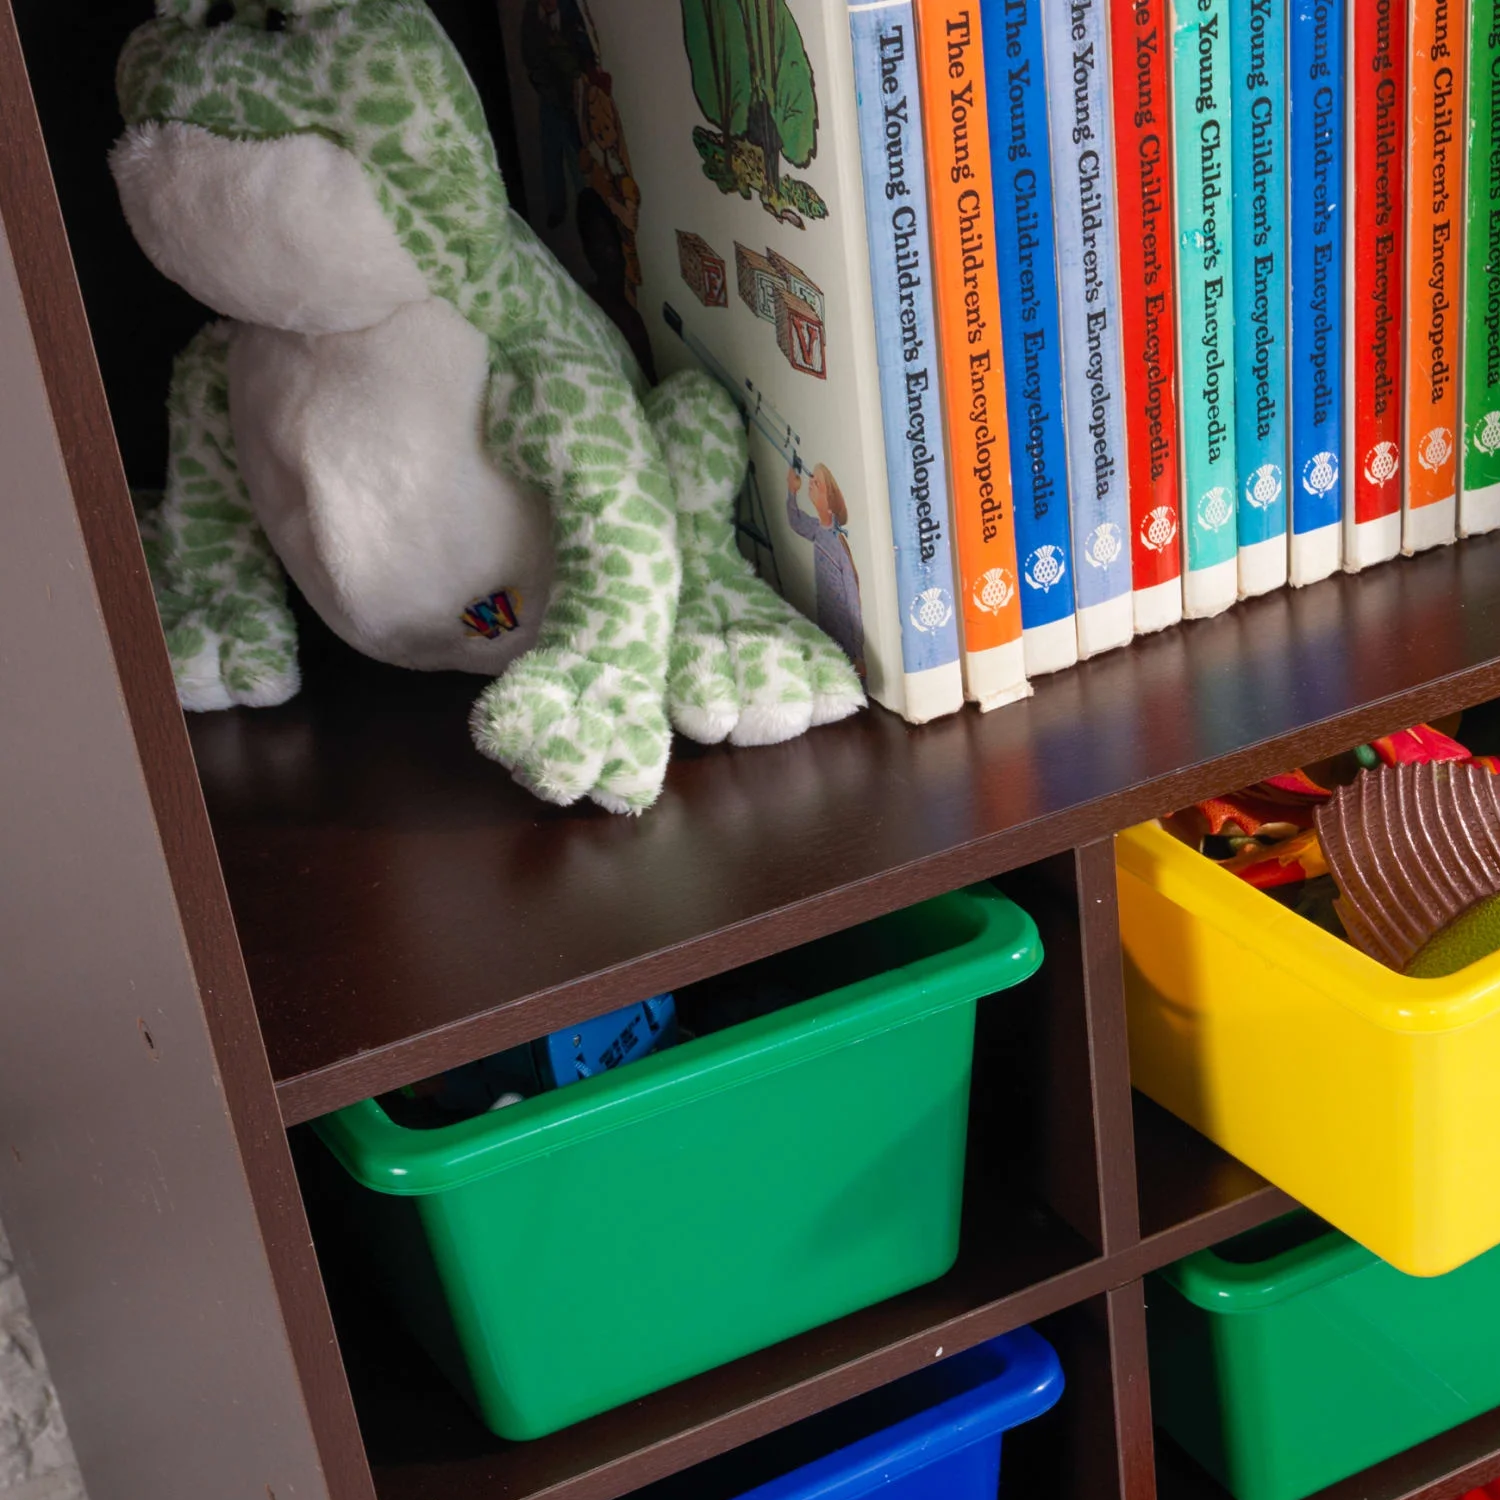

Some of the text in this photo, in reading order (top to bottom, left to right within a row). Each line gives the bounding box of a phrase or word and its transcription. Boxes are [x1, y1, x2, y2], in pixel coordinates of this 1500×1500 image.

[1134, 27, 1158, 128] Young
[1196, 13, 1219, 114] Young
[1070, 0, 1115, 500] he Young Children's Encyclopedia
[1139, 134, 1162, 286] Children's
[1200, 119, 1223, 271] Children's
[1246, 0, 1276, 441] Young Children's Encyclopedia
[1313, 86, 1334, 235] Children's
[1371, 0, 1396, 417] oung Children's Encyclopedia
[1428, 0, 1453, 404] ung Children's Encyclopedia
[792, 317, 818, 367] V
[879, 25, 942, 563] The Young Children's Encyclopedia
[946, 10, 1003, 543] The Young Children's Encyclopedia
[1004, 0, 1055, 520] The Young Children's Encyclopedia
[1310, 241, 1333, 428] Encyclopedia
[1143, 291, 1170, 481] Encyclopedia
[1201, 276, 1227, 464] Encyclopedia
